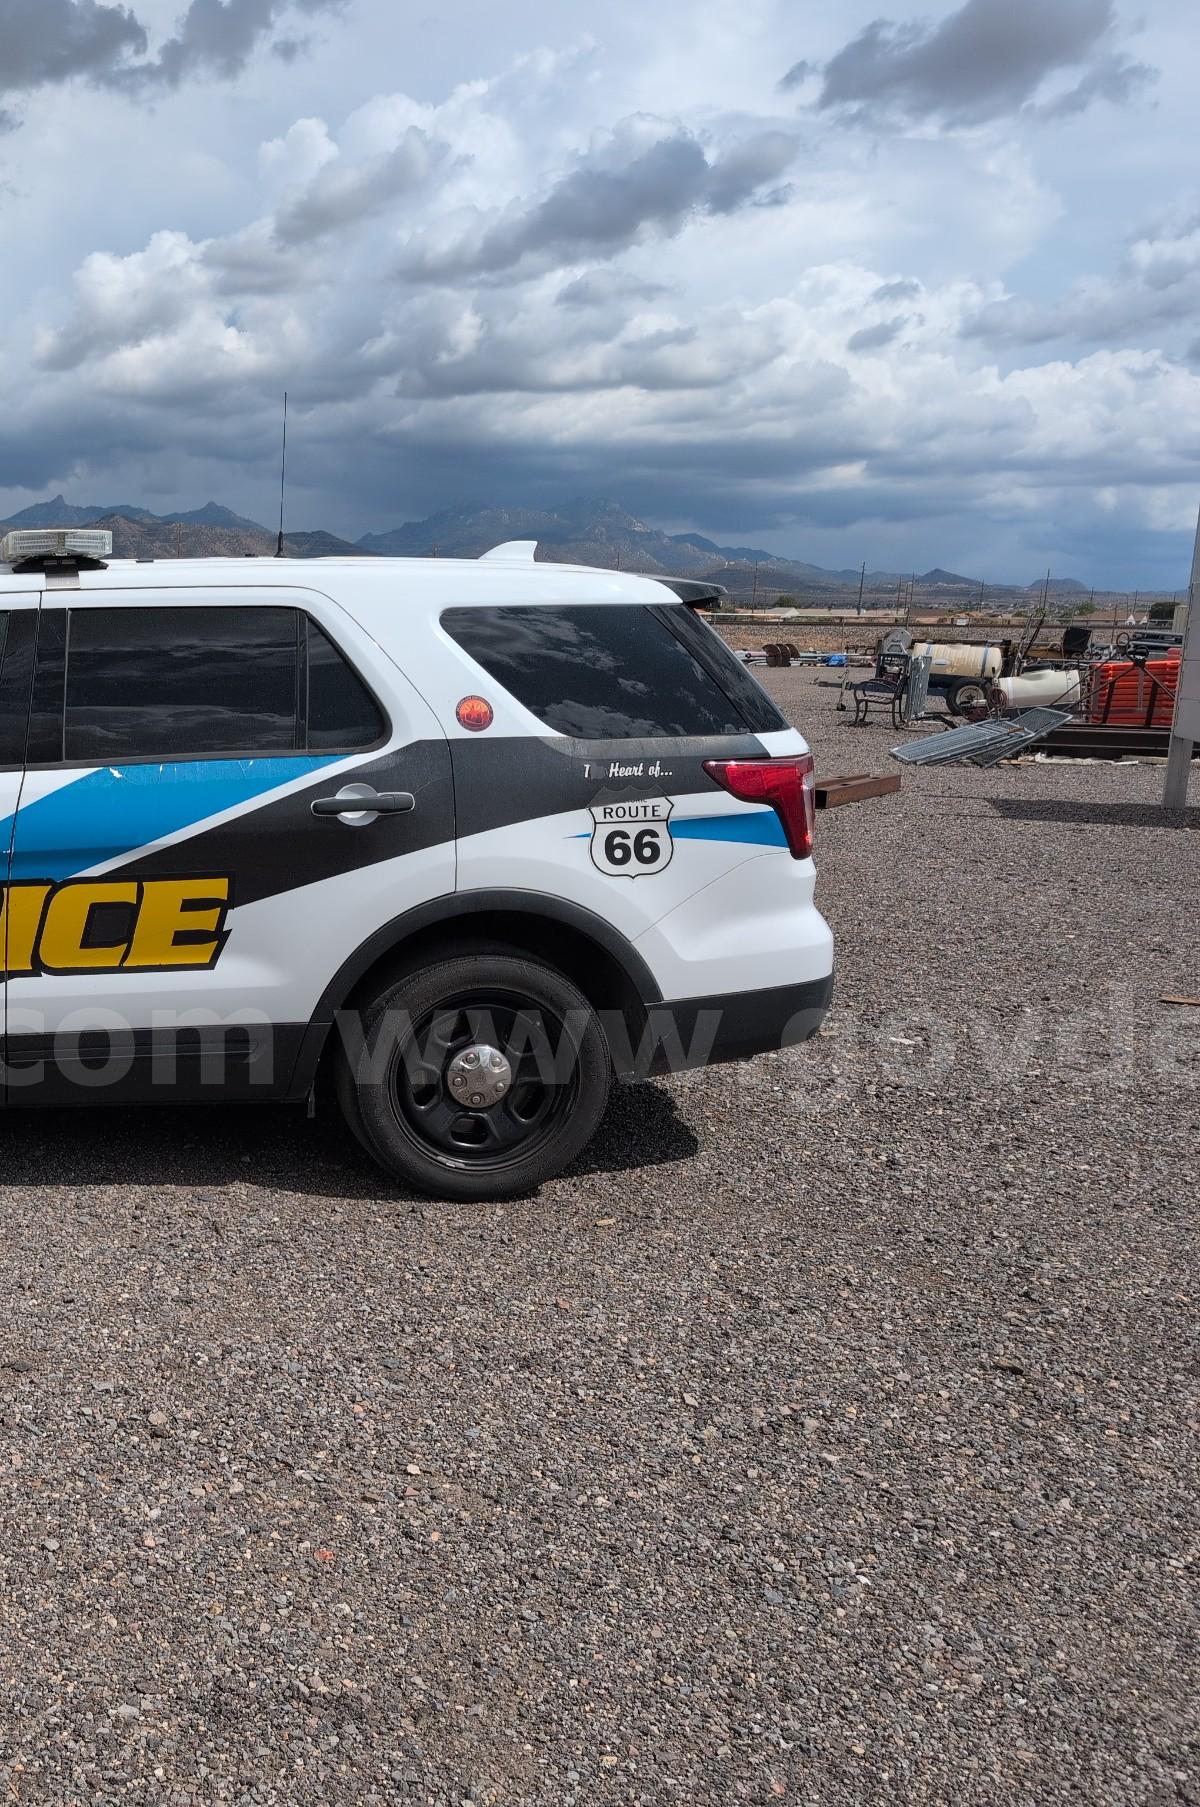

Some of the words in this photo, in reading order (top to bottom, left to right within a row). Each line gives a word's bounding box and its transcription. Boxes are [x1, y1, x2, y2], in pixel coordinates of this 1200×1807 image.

[608, 761, 644, 778] Heart
[603, 804, 662, 819] ROUTE
[604, 828, 661, 866] 66
